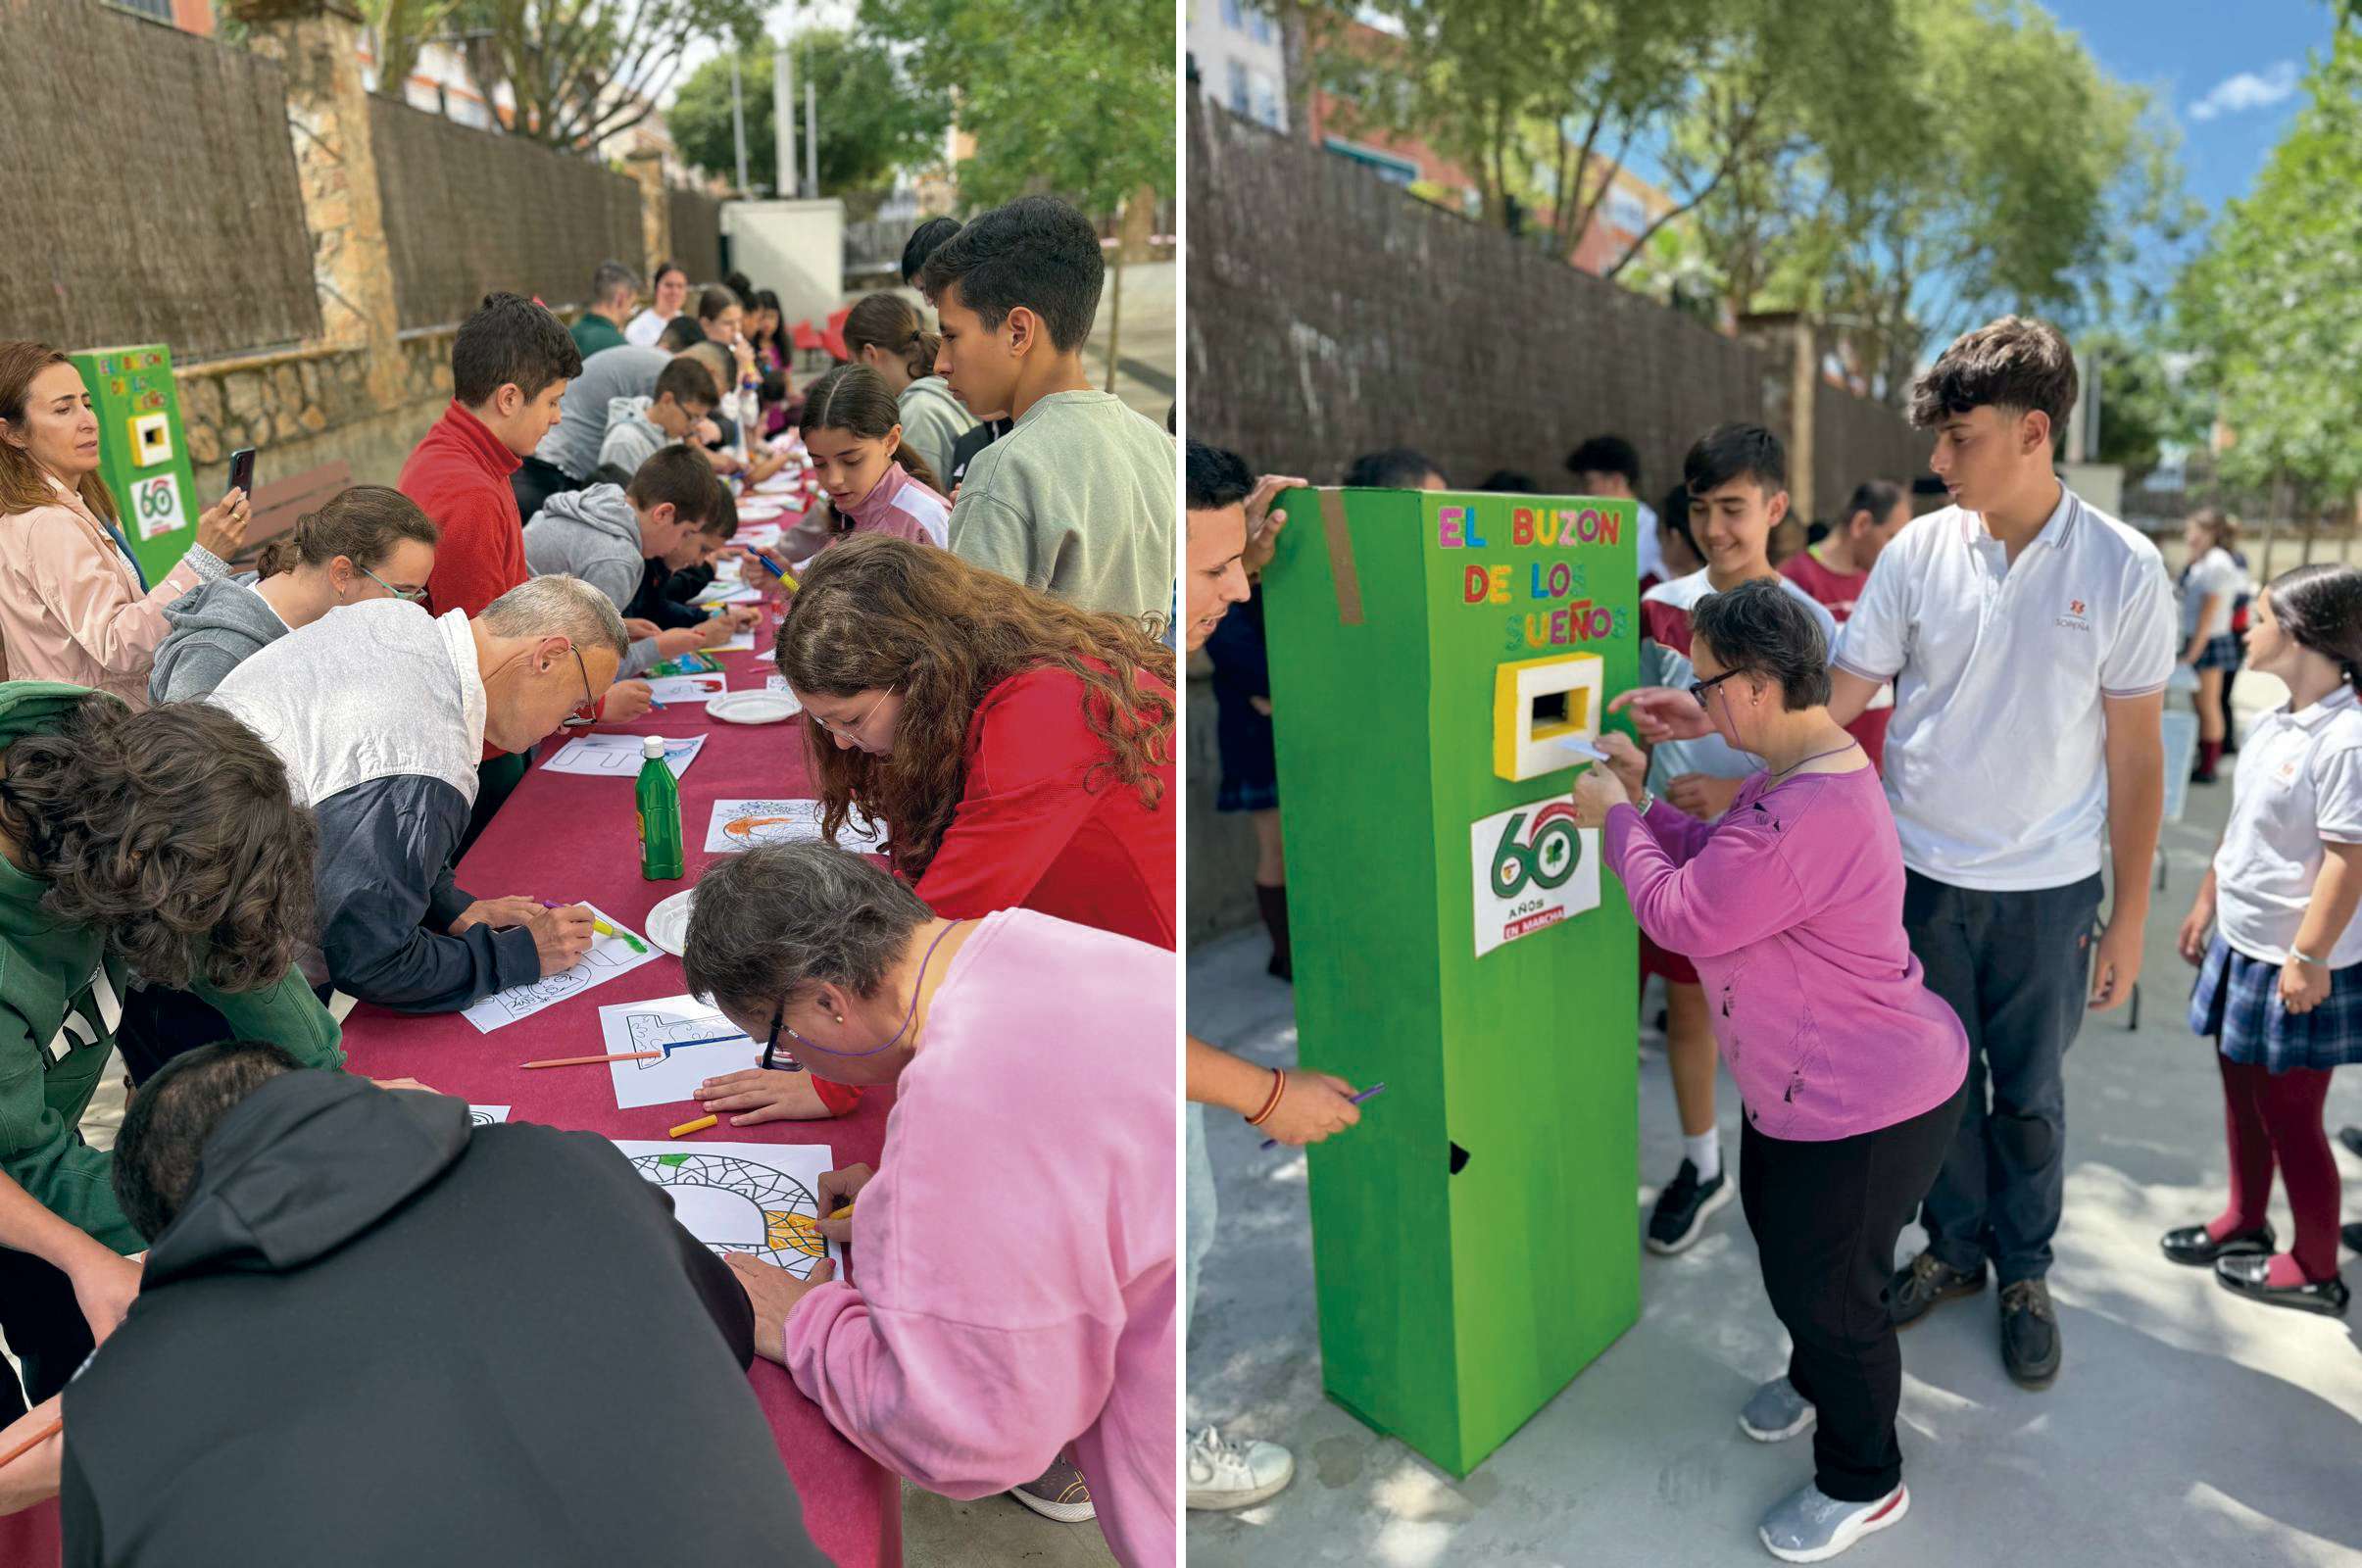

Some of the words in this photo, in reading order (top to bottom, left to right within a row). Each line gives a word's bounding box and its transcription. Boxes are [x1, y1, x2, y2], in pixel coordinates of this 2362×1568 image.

[141, 481, 172, 517] 60
[1439, 506, 1488, 549] EL
[1512, 508, 1620, 547] BUZON
[1463, 564, 1512, 605] DE
[1531, 562, 1586, 600] LOS
[1504, 599, 1628, 652] SUEÑOS
[1491, 812, 1582, 899] 60
[1508, 898, 1545, 919] AÑOS
